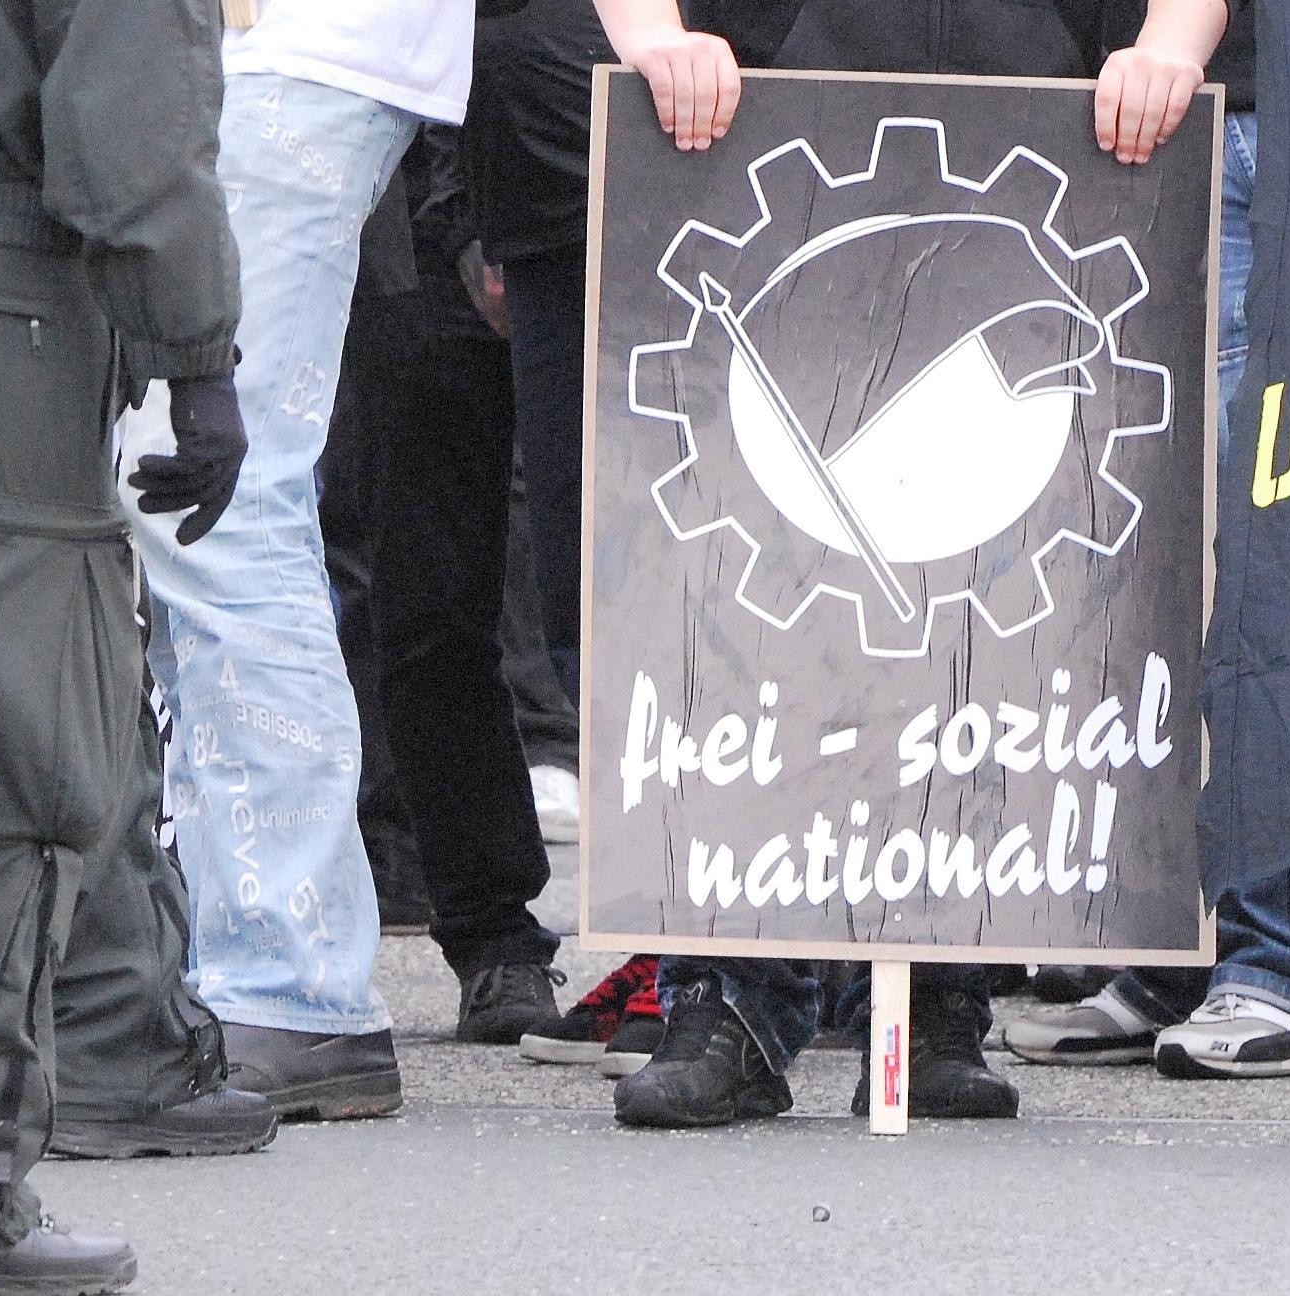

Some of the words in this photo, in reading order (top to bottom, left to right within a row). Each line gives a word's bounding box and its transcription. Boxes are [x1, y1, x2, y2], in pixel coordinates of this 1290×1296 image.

[620, 670, 783, 813] frei
[897, 651, 1174, 788] sozial
[223, 758, 271, 929] never
[687, 779, 1117, 909] national!
